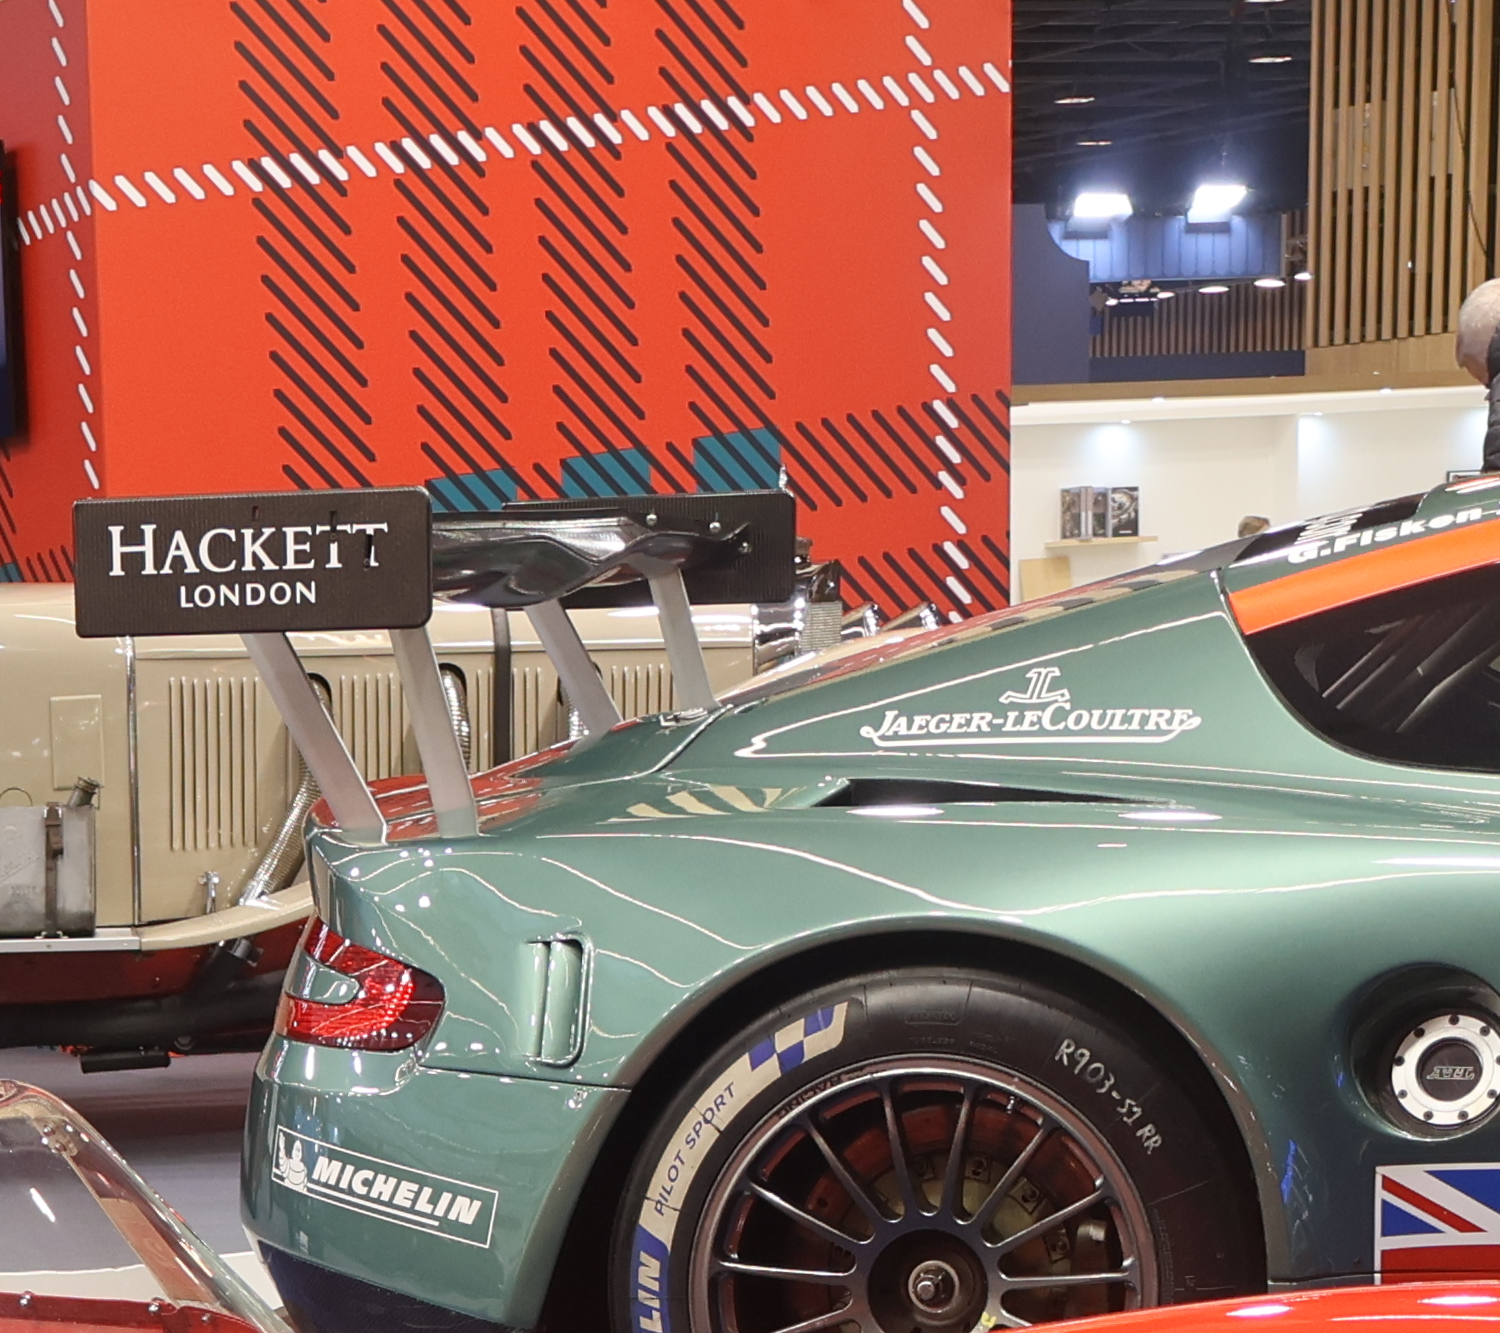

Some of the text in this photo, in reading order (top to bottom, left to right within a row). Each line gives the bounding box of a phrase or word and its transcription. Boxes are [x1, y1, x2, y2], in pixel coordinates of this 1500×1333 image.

[107, 520, 390, 577] HACKETT
[178, 580, 318, 610] LONDON
[652, 1079, 737, 1219] PILOT SPORT
[310, 1154, 483, 1227] MICHELIN
